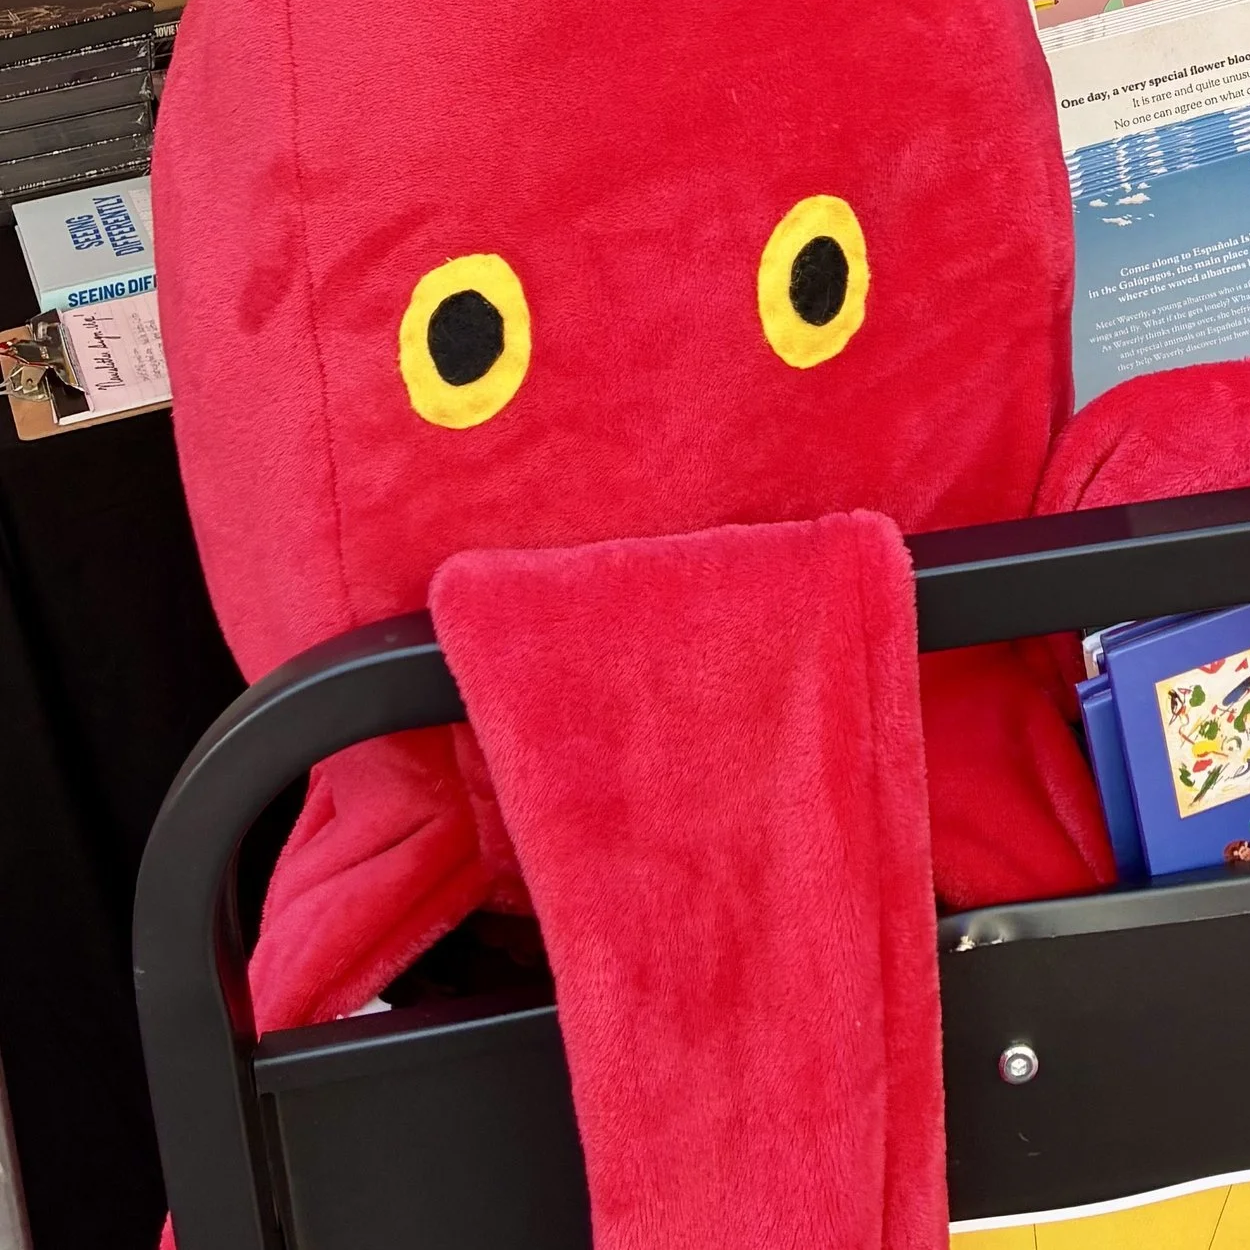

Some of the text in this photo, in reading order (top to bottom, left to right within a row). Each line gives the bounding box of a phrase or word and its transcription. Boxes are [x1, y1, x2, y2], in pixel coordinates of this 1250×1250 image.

[1061, 98, 1085, 109] One
[1087, 91, 1110, 102] day,
[1113, 88, 1120, 96] a
[1121, 81, 1147, 93] very
[1149, 68, 1188, 87] special
[1190, 60, 1226, 76] flower
[1132, 98, 1140, 108] It
[1141, 96, 1150, 106] is
[1151, 91, 1172, 103] rare
[1174, 83, 1194, 97] and
[1195, 79, 1221, 93] quite
[1114, 118, 1130, 130] No
[1132, 114, 1152, 125] one
[1153, 109, 1173, 119] can
[1175, 101, 1203, 115] agree
[1204, 97, 1218, 106] on
[1219, 89, 1245, 102] what
[65, 214, 104, 250] SEEING
[92, 195, 145, 256] DIFFERENTLY
[1089, 290, 1099, 299] in
[1101, 286, 1117, 295] the
[1119, 270, 1175, 290] Galápagos,
[1177, 265, 1193, 274] the
[1194, 256, 1221, 269] main
[1223, 249, 1249, 262] place
[1120, 264, 1150, 277] Come
[1152, 255, 1180, 268] along
[1192, 238, 1239, 257] Española
[68, 282, 125, 308] SEEING
[1118, 290, 1149, 303] where
[1150, 285, 1166, 294] the
[1168, 274, 1199, 289] waved
[1201, 263, 1247, 280] albatross
[1089, 333, 1113, 343] wings
[1114, 327, 1129, 337] and
[1143, 318, 1165, 328] What
[1166, 314, 1172, 322] if
[1188, 308, 1203, 318] gets
[1204, 298, 1230, 312] lonely?
[1096, 319, 1116, 330] Meet
[1116, 310, 1151, 324] Waverly,
[1157, 302, 1183, 315] young
[1183, 292, 1217, 306] albatross
[1218, 287, 1235, 295] who
[1102, 345, 1112, 353] As
[1113, 335, 1144, 349] Waverly
[1145, 328, 1171, 340] thinks
[1171, 322, 1196, 333] things
[1117, 363, 1134, 372] they
[1135, 357, 1153, 367] help
[1153, 348, 1184, 361] Waverly
[1186, 339, 1217, 353] discover
[1218, 334, 1233, 345] just
[1233, 330, 1249, 339] how
[1120, 349, 1135, 359] and
[1136, 341, 1163, 355] special
[1164, 333, 1195, 347] animals
[1207, 319, 1243, 335] Española
